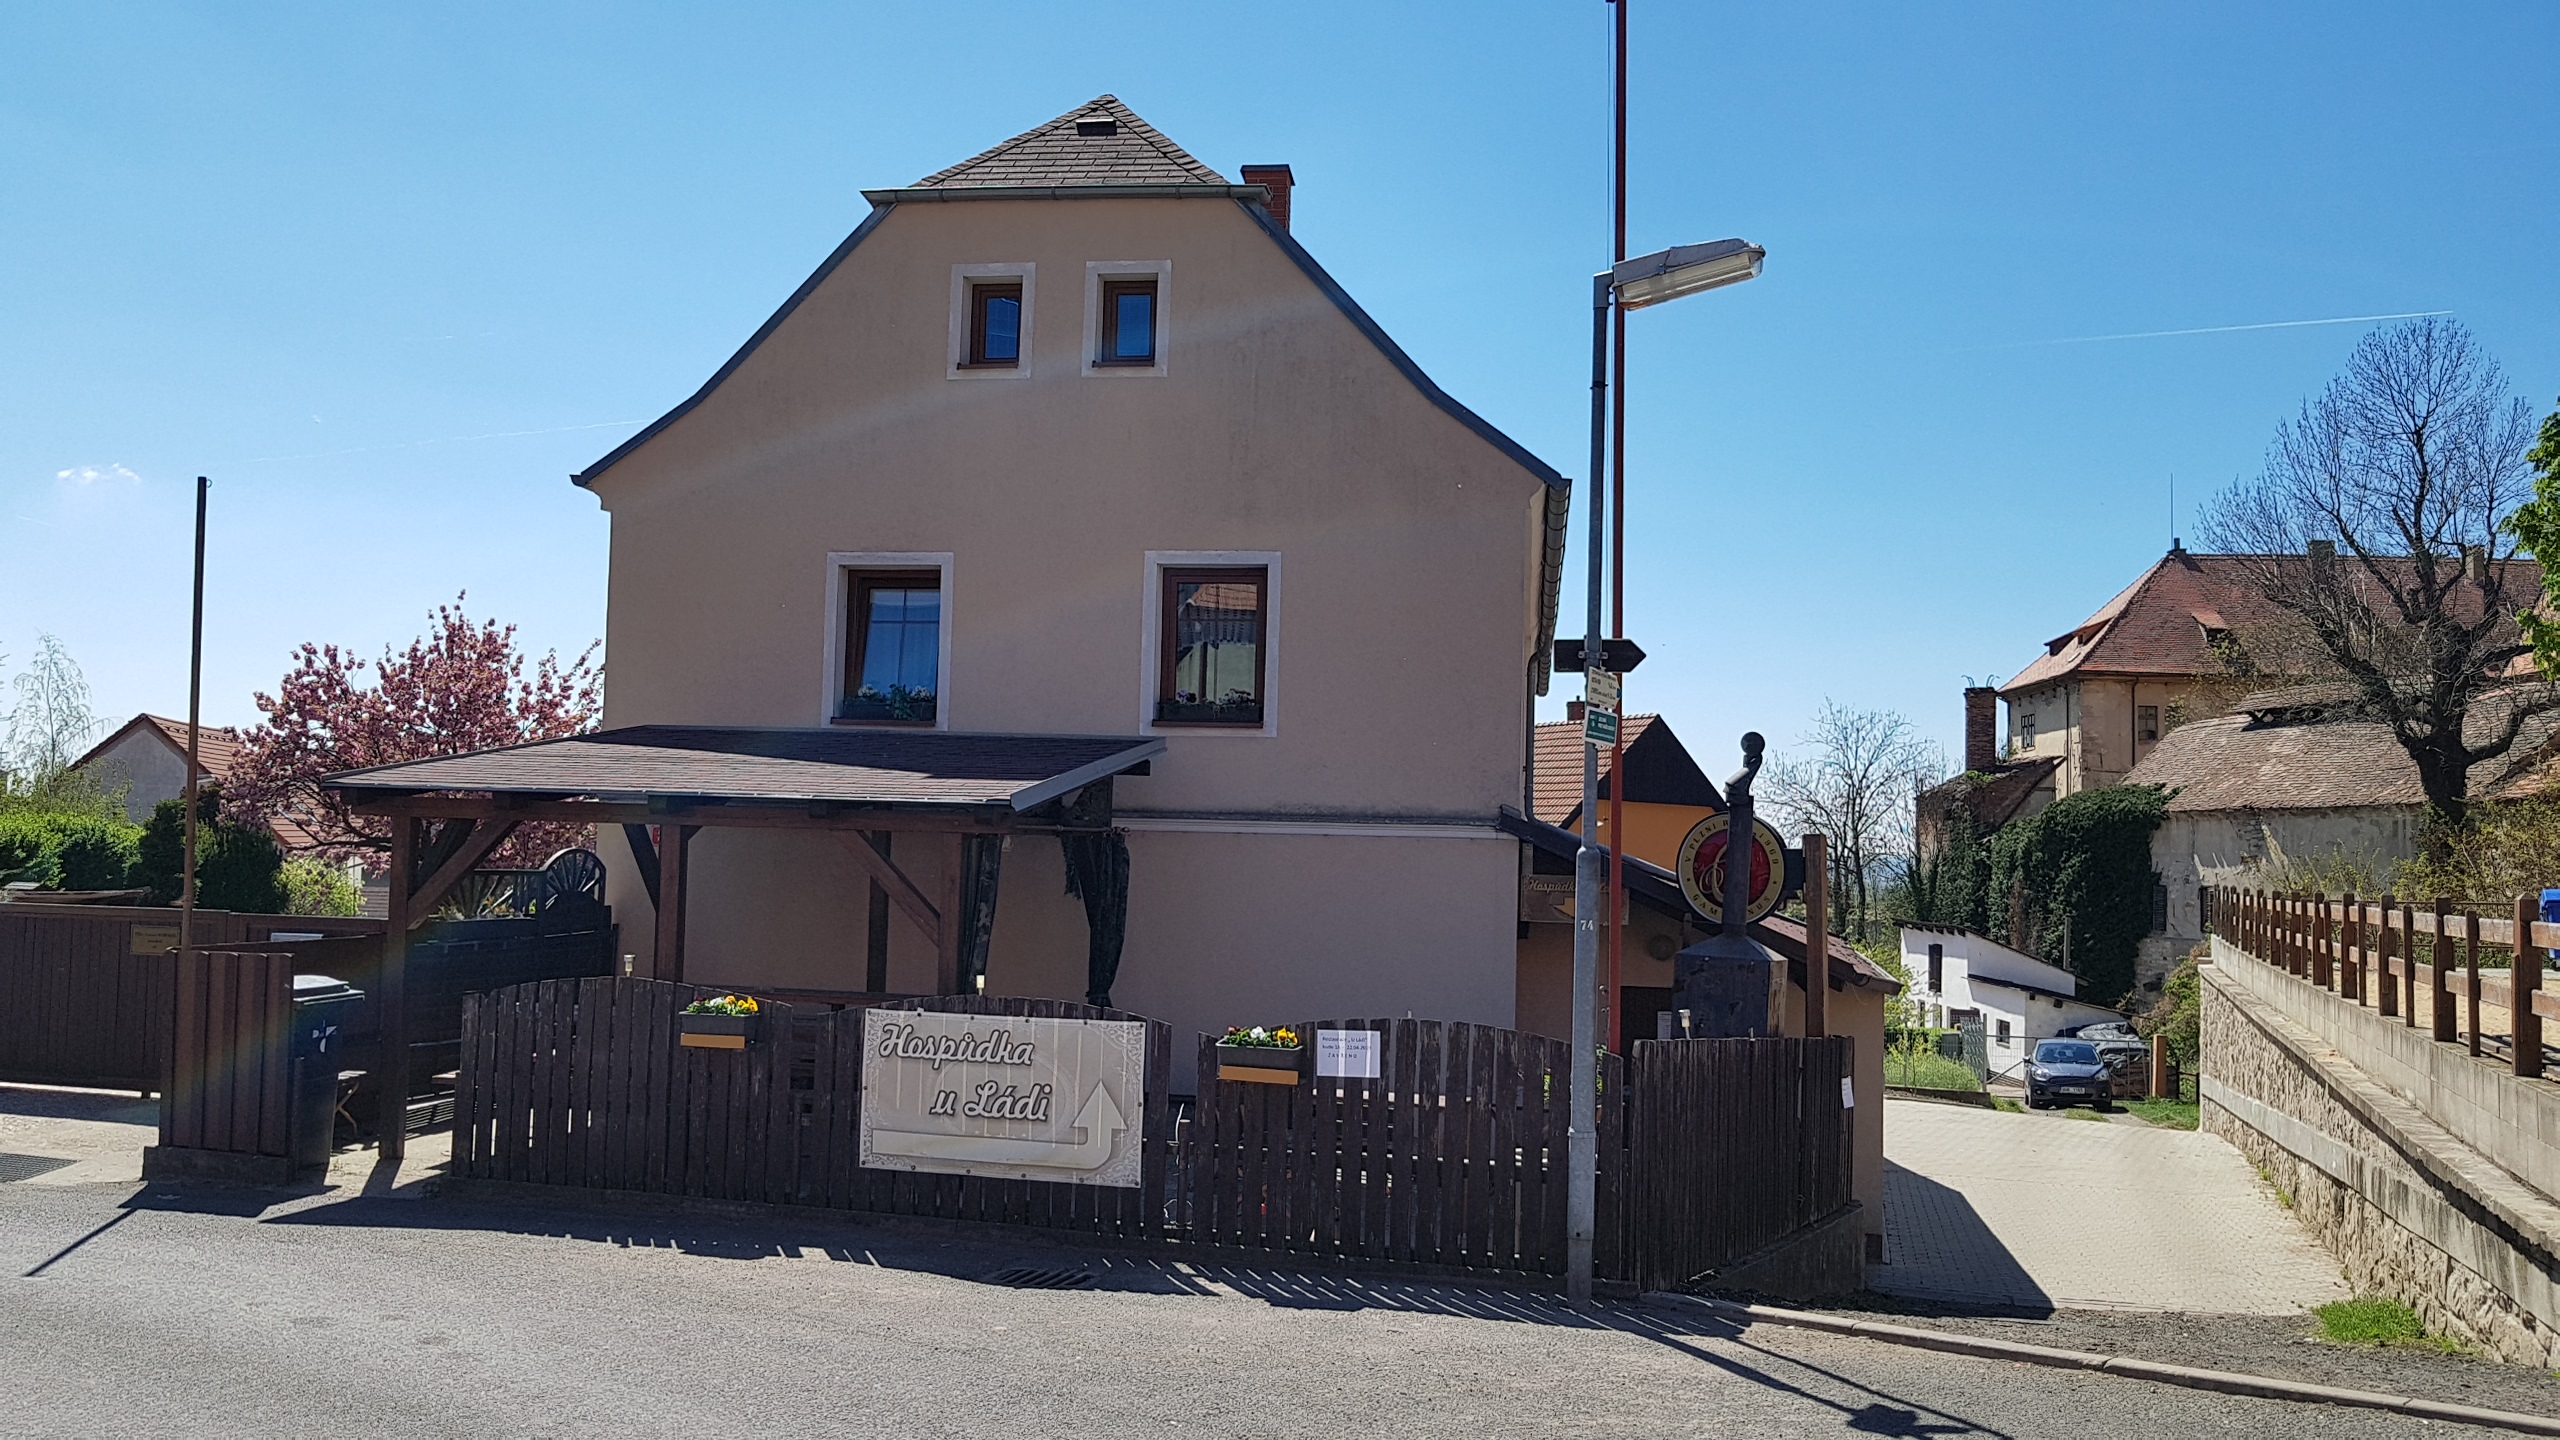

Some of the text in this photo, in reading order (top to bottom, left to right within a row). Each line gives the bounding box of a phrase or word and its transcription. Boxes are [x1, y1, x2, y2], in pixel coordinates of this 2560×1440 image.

[1690, 823, 1715, 850] PLZNI
[1527, 878, 1575, 894] Hospůdk
[1693, 895, 1770, 917] GAMNUS
[1580, 919, 1594, 931] 74
[879, 1023, 1035, 1070] Hospůdka
[929, 1079, 1053, 1122] u Ládi
